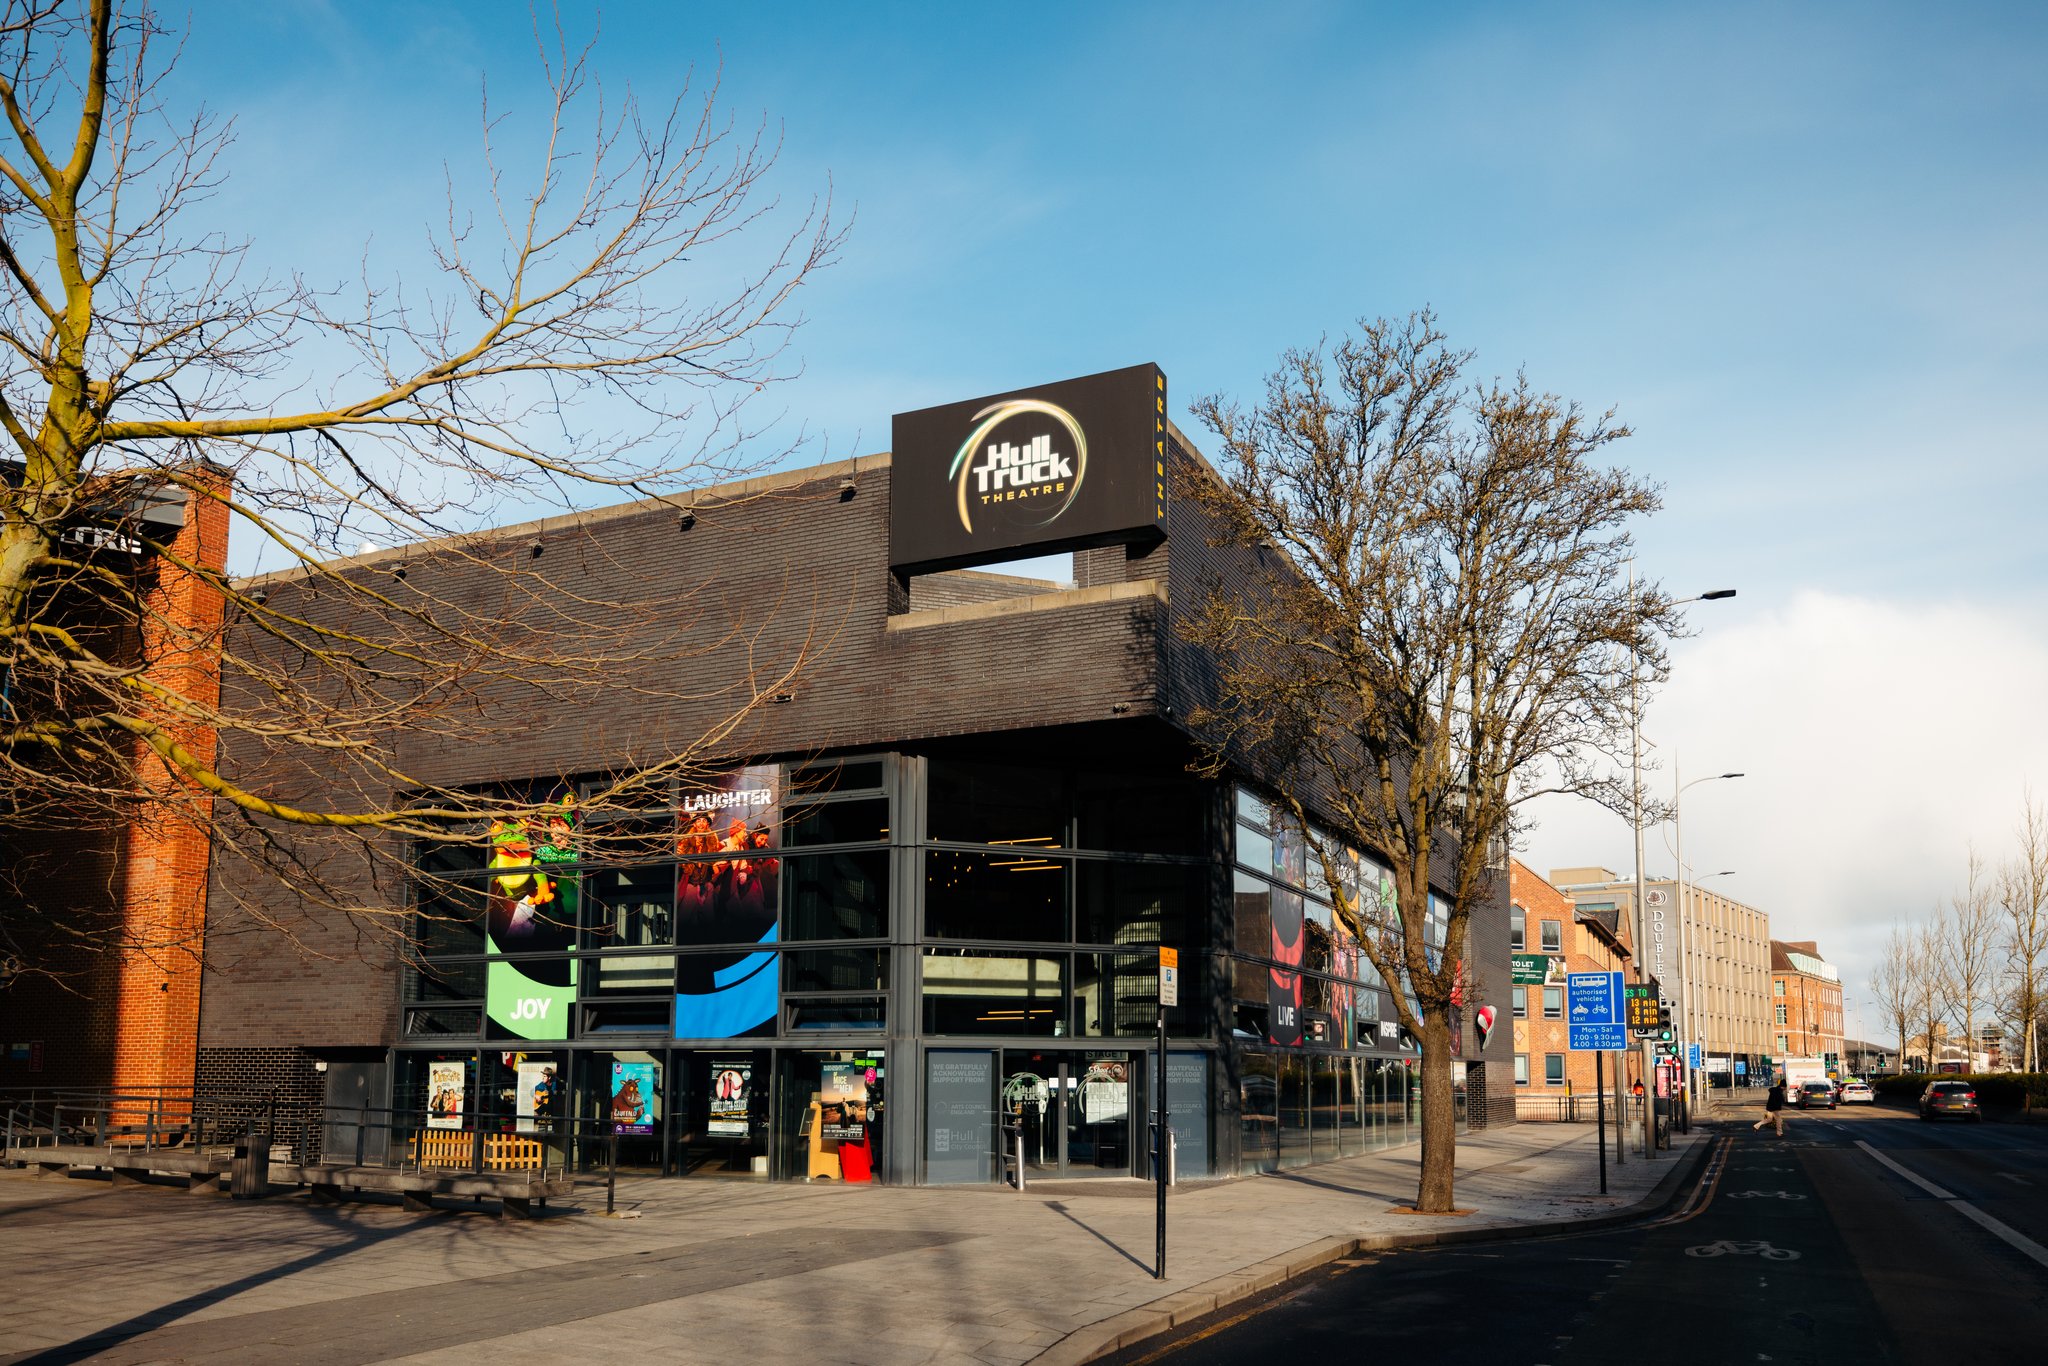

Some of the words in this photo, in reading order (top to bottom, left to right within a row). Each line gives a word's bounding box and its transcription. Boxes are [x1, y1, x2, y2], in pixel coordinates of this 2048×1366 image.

[987, 434, 1050, 470] Hull
[1156, 375, 1164, 520] THEATRE
[973, 453, 1072, 493] Truck
[981, 482, 1065, 505] THEATRE
[684, 788, 772, 811] LAUGHTER
[1652, 911, 1666, 1007] DOUBLETRE
[1631, 998, 1640, 1007] 13
[1643, 998, 1657, 1007] min
[1638, 989, 1647, 997] TO
[510, 998, 552, 1020] JOY
[1278, 1006, 1294, 1026] LIVE
[1632, 1016, 1640, 1024] 12
[1644, 1016, 1658, 1024] min
[1643, 1007, 1657, 1015] min
[951, 1130, 973, 1141] Hull
